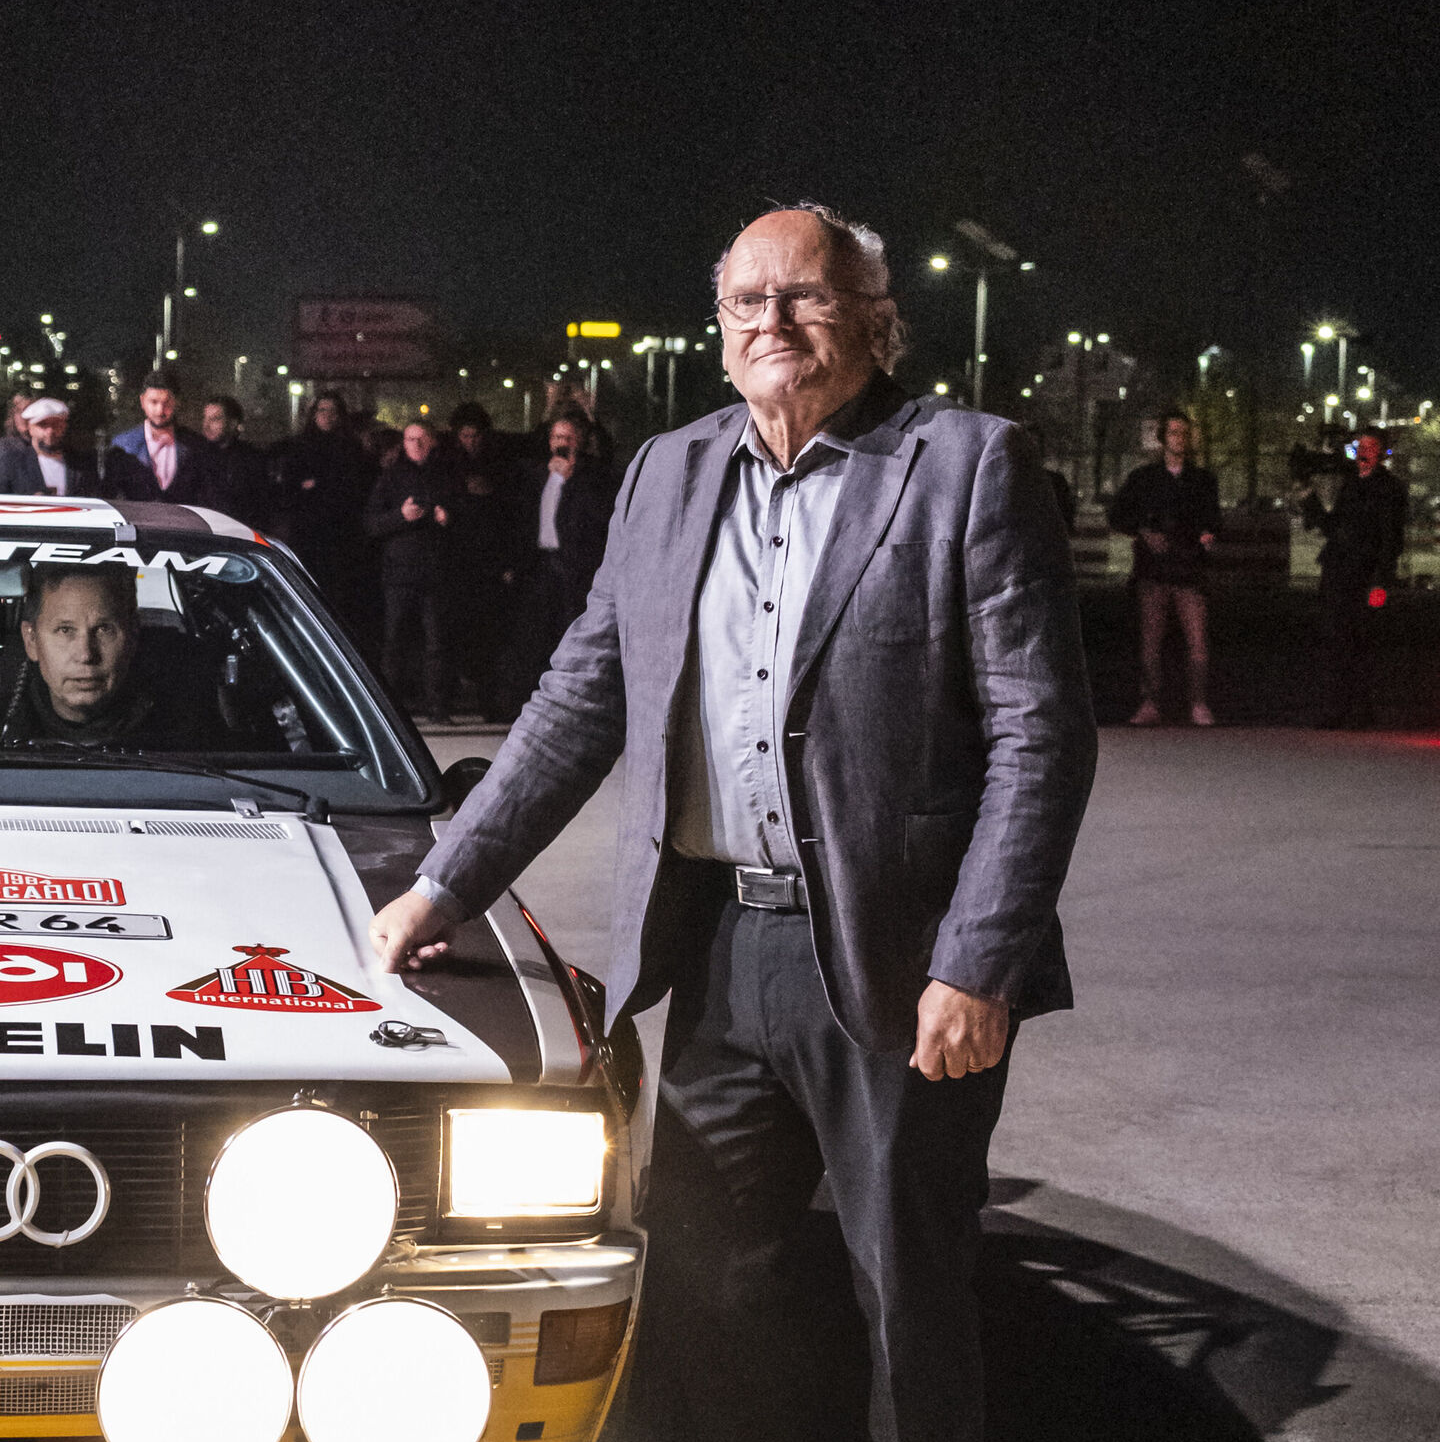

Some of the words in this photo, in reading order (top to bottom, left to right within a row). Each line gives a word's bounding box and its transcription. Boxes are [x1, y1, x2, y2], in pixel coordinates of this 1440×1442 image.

[40, 914, 126, 934] 64
[215, 968, 325, 998] HB
[194, 993, 354, 1010] international
